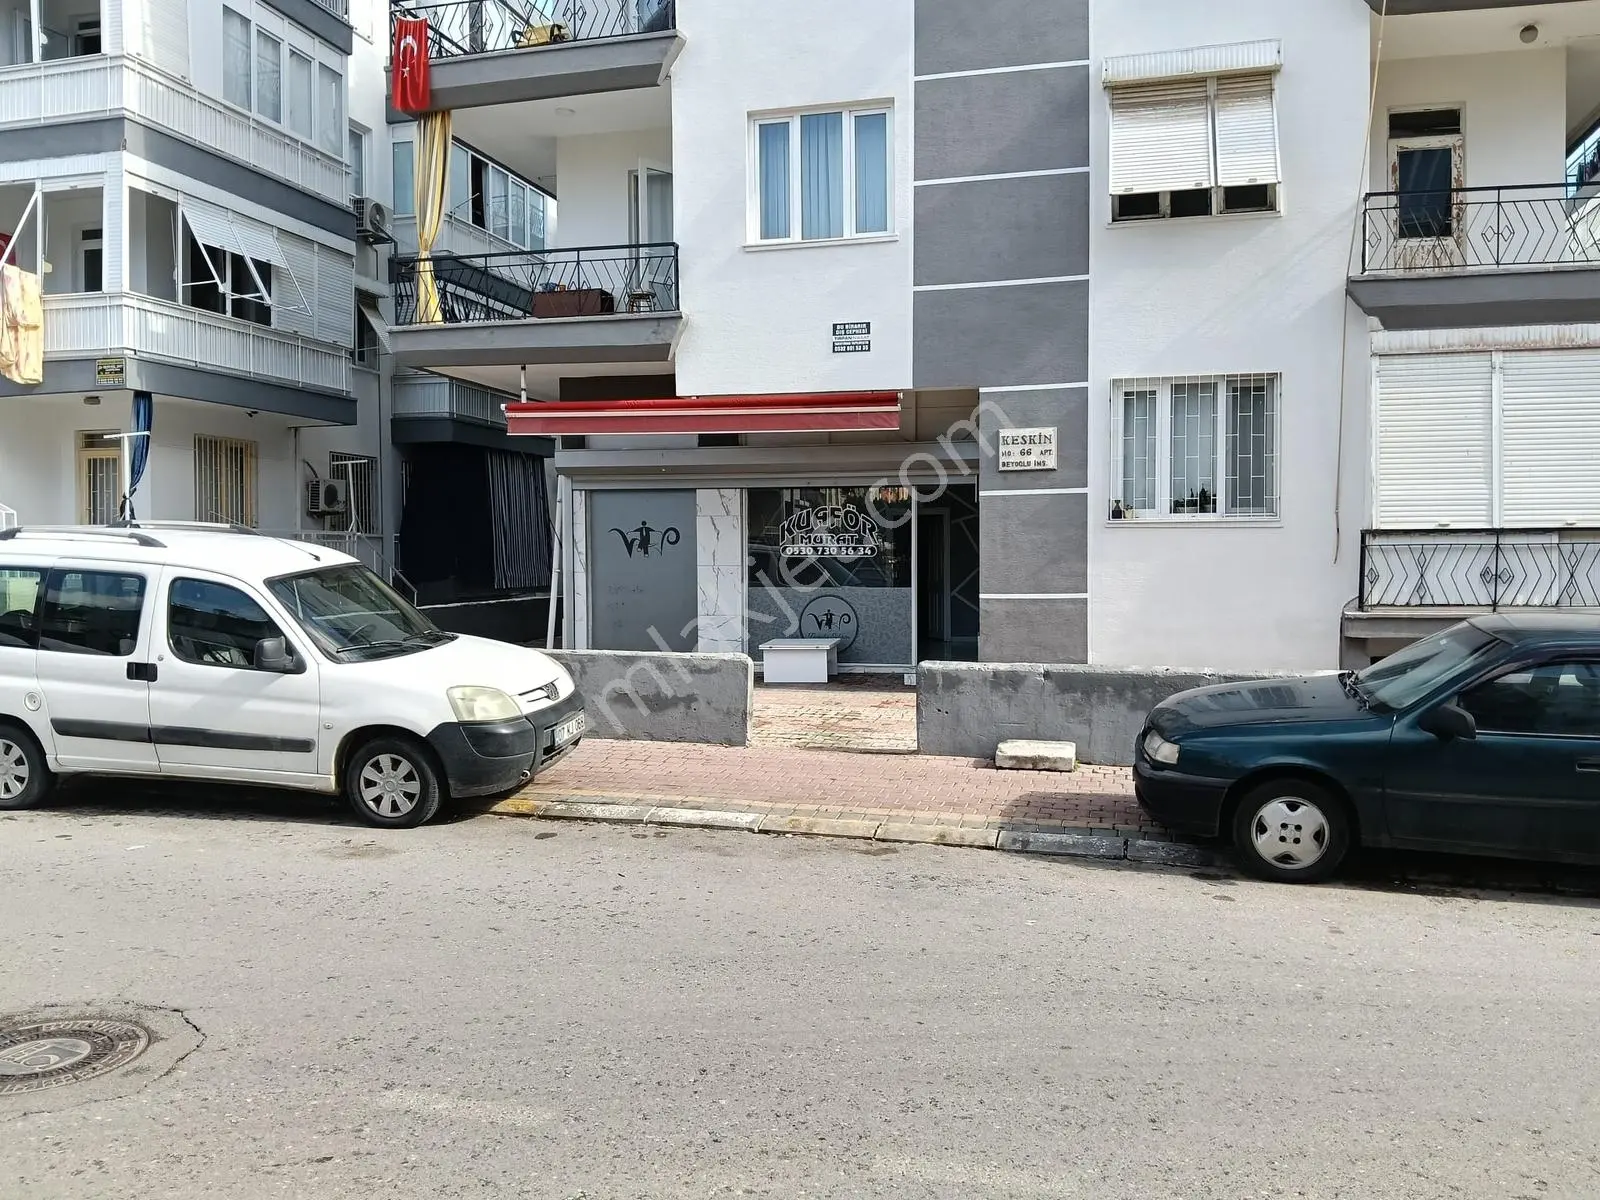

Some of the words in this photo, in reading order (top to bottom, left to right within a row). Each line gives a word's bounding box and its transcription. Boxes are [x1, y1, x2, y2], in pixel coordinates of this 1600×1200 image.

[1001, 432, 1053, 445] KESKİN
[1019, 448, 1032, 456] 66
[779, 503, 879, 546] KUAFÖR
[799, 533, 859, 545] MURAT
[786, 546, 813, 555] 0530
[817, 546, 837, 555] 730
[841, 546, 854, 555] 56
[857, 546, 872, 555] 34
